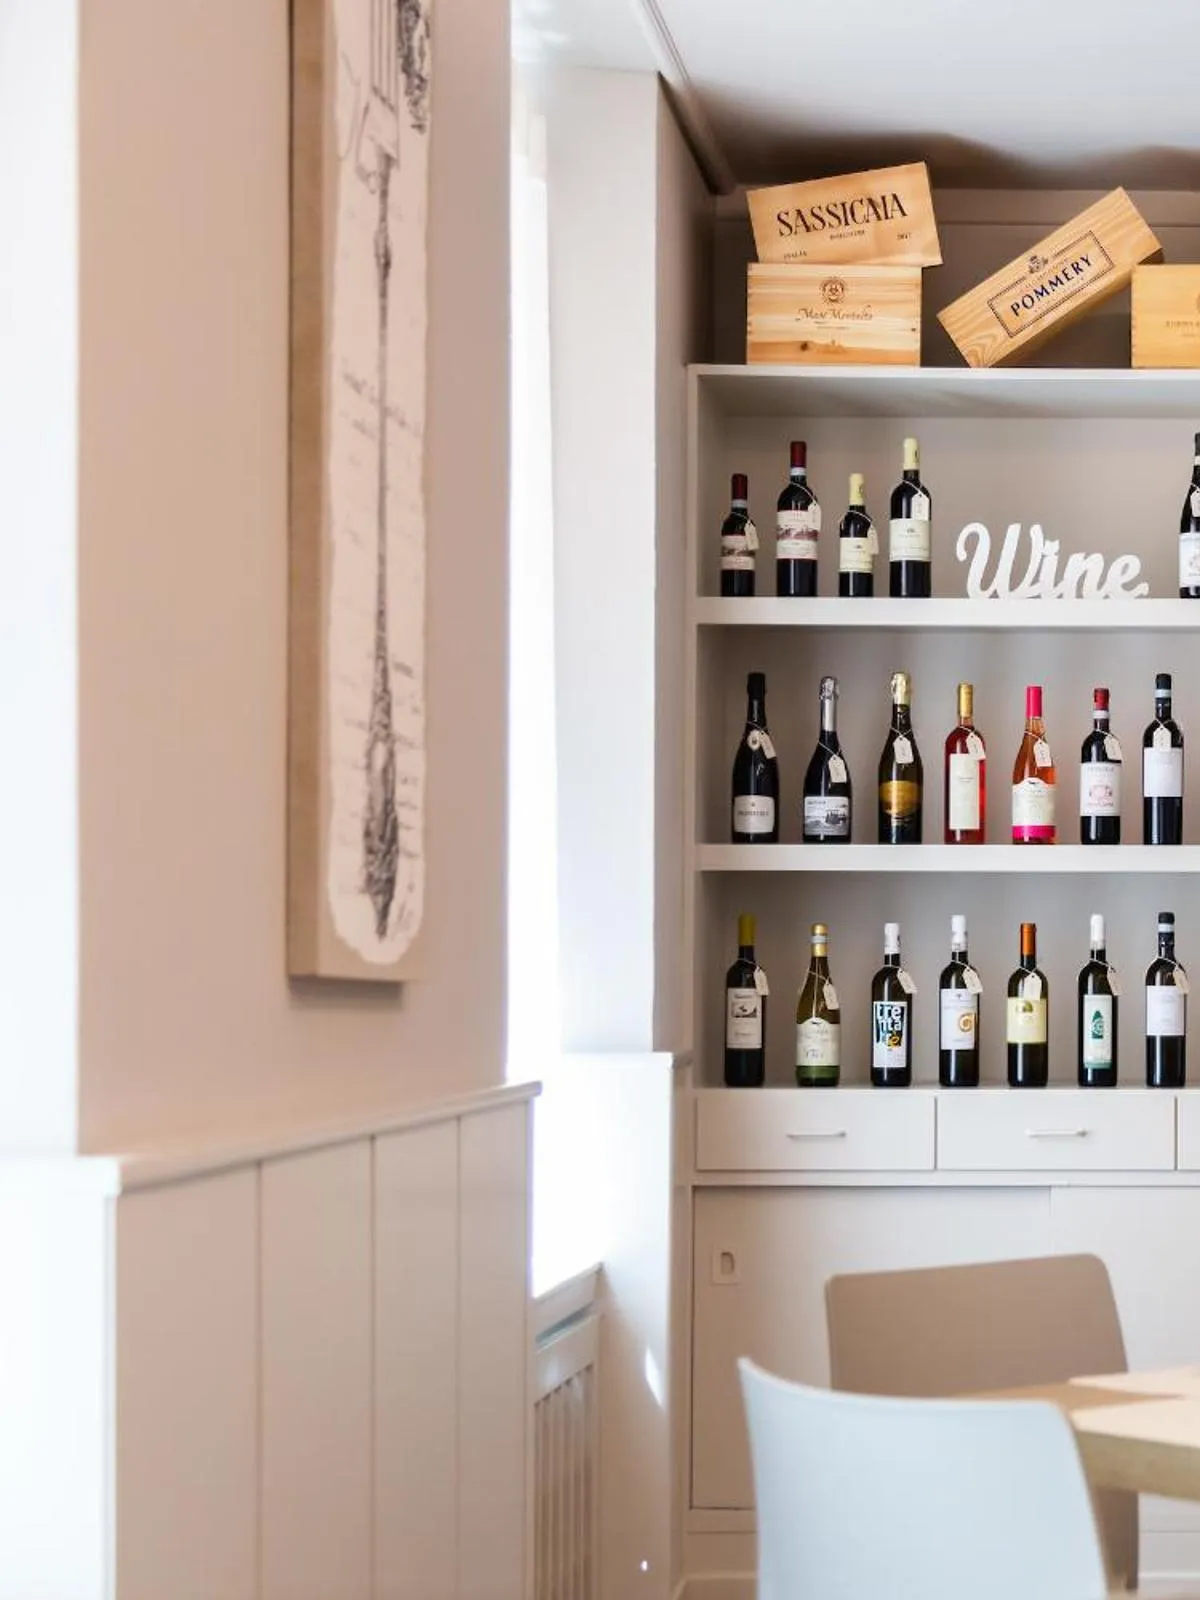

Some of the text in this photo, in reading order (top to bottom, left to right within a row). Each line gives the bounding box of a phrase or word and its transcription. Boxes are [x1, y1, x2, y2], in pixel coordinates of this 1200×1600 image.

[776, 192, 908, 237] SASSICAIA
[1009, 253, 1093, 317] POMMERY
[956, 522, 1150, 599] Wine
